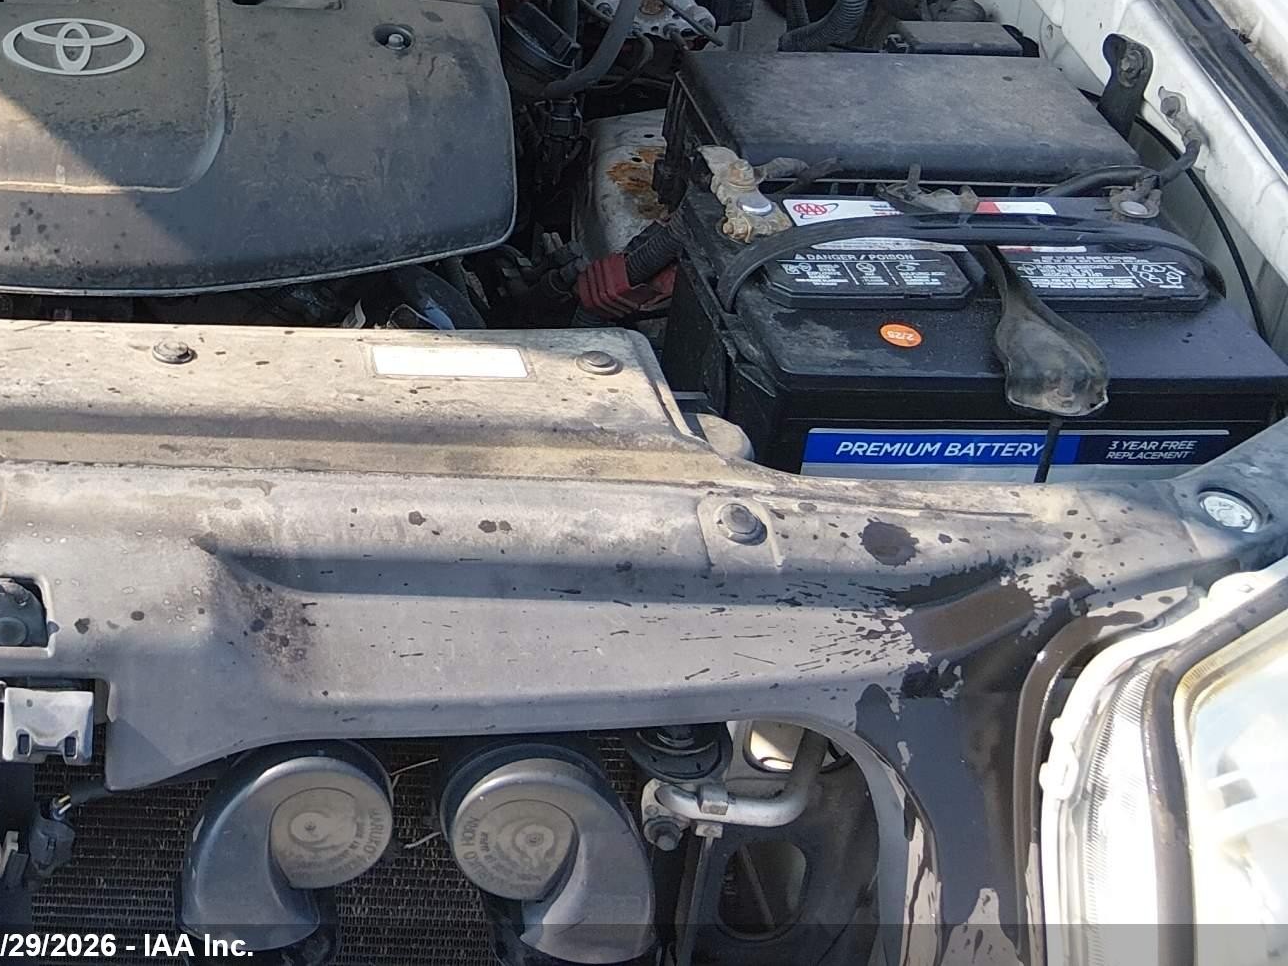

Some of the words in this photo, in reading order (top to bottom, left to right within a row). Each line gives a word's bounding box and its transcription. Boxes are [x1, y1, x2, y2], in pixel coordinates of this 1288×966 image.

[794, 203, 827, 215] AAA
[805, 253, 857, 261] DANGER
[868, 253, 915, 261] POISON
[835, 441, 942, 457] PREMIUM
[943, 441, 1045, 458] BATTERY
[1107, 440, 1117, 450] 3
[1120, 440, 1158, 451] YEAR
[1159, 440, 1199, 450] FREE
